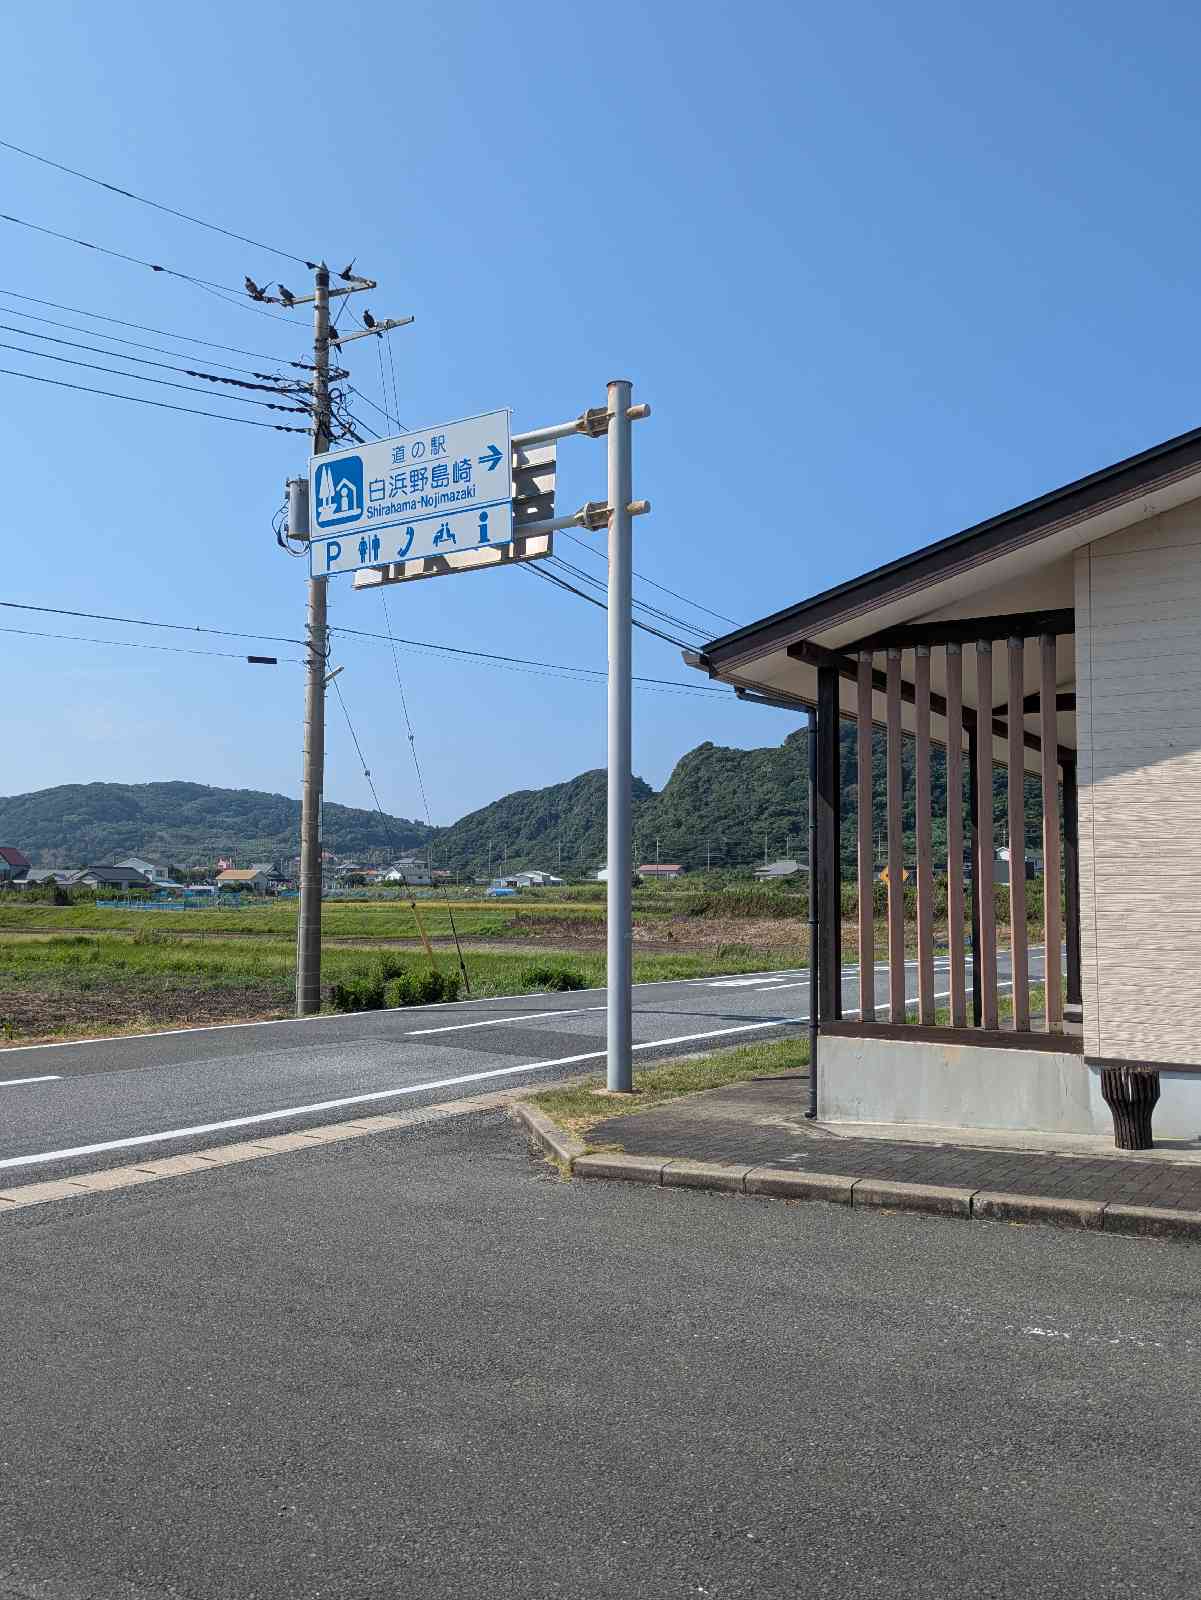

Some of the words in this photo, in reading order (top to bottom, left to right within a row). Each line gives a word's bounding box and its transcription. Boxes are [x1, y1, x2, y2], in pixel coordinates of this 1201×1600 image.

[391, 434, 447, 465] 道の駅
[368, 458, 473, 502] 白浜野島崎
[366, 484, 476, 520] Shirahama-Nojimazaki
[326, 541, 342, 571] P
